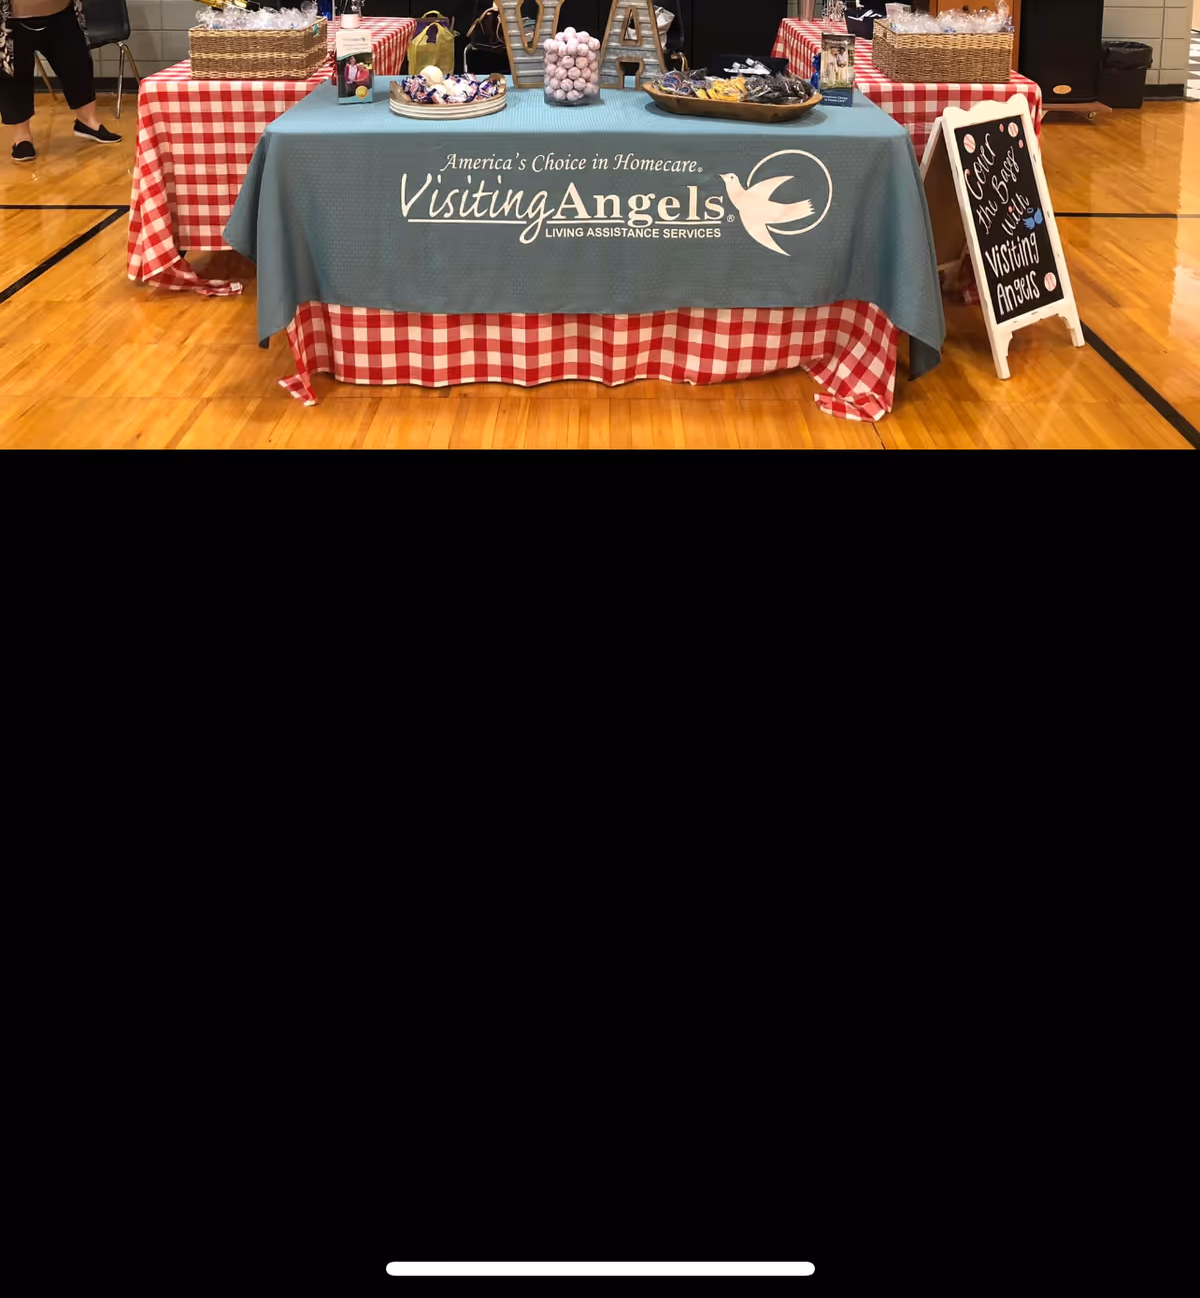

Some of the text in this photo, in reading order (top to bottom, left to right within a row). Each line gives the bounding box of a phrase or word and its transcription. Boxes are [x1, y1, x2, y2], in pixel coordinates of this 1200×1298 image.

[440, 153, 527, 172] America's
[531, 152, 587, 173] Choice
[592, 153, 609, 170] in
[965, 133, 997, 200] Cover
[400, 172, 555, 244] Visiting
[976, 200, 997, 234] the
[1002, 193, 1029, 235] with
[545, 227, 722, 239] LIVING ASSISTANCE SERVICES
[985, 232, 1039, 278] Visiting
[997, 271, 1040, 316] Angels
